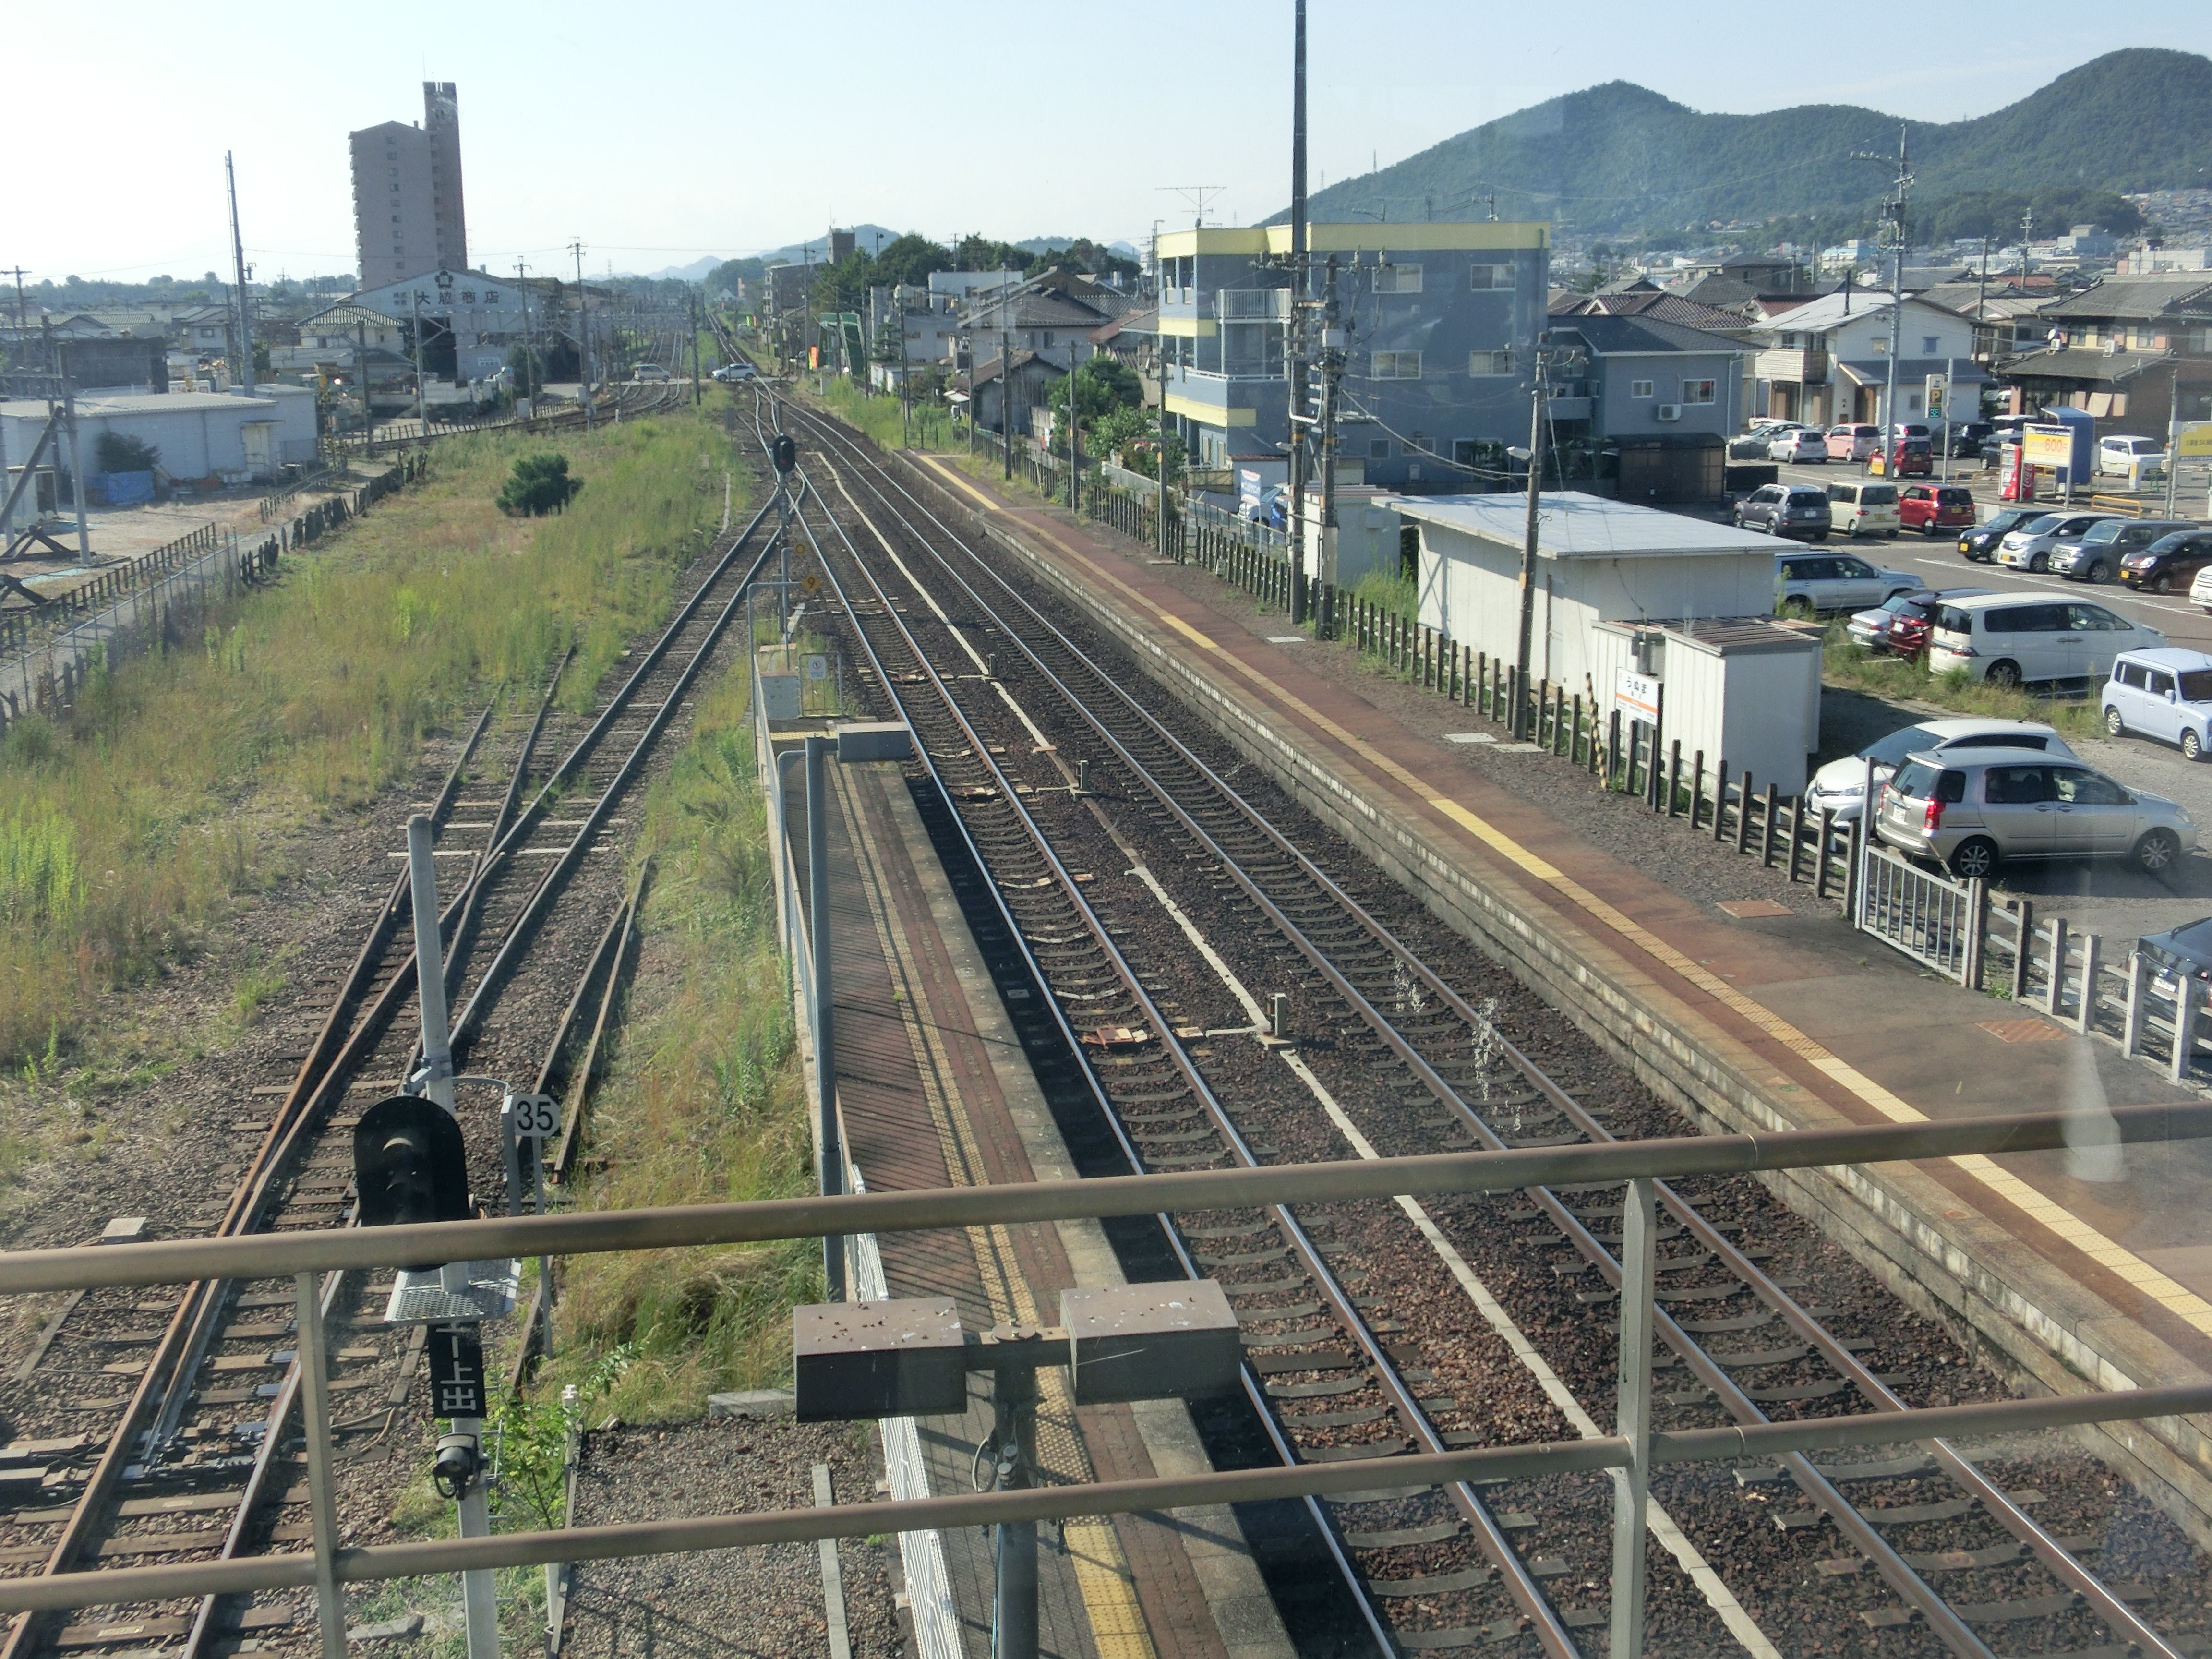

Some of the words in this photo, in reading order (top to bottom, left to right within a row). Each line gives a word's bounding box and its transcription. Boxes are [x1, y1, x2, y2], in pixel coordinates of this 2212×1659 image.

[1932, 390, 1941, 402] P
[808, 577, 815, 589] 9
[1626, 676, 1647, 694] うぬま
[517, 1100, 553, 1131] 35
